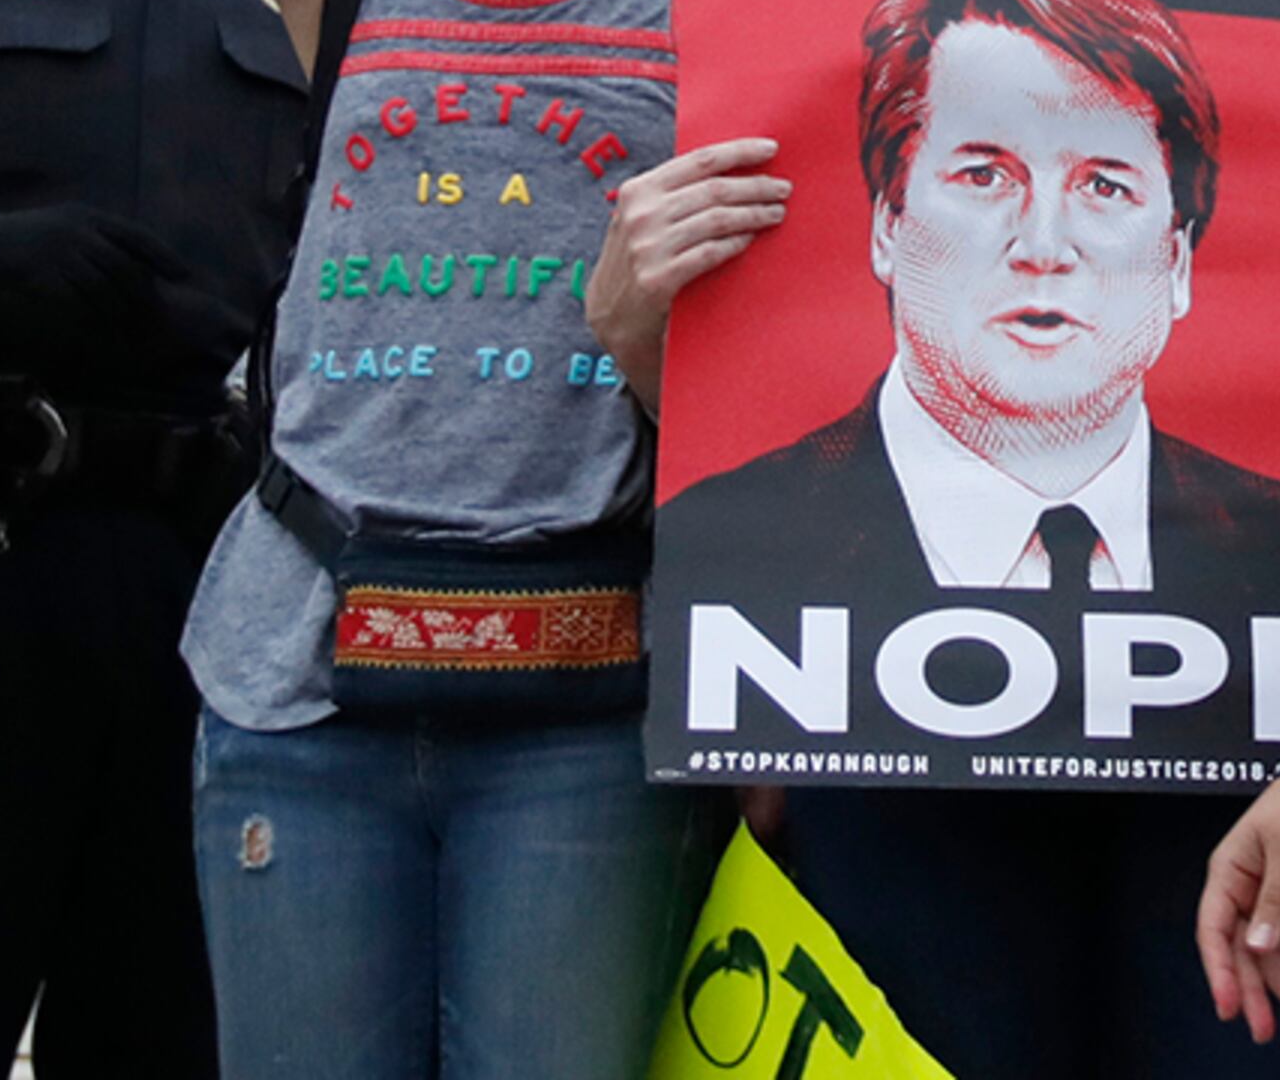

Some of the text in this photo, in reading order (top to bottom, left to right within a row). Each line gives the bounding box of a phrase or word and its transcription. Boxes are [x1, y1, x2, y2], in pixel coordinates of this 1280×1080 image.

[329, 82, 629, 218] TOGETHE
[417, 171, 532, 206] IS A
[476, 347, 534, 380] TO
[567, 352, 619, 384] BE
[688, 751, 929, 774] #STOPKAVANAUGH
